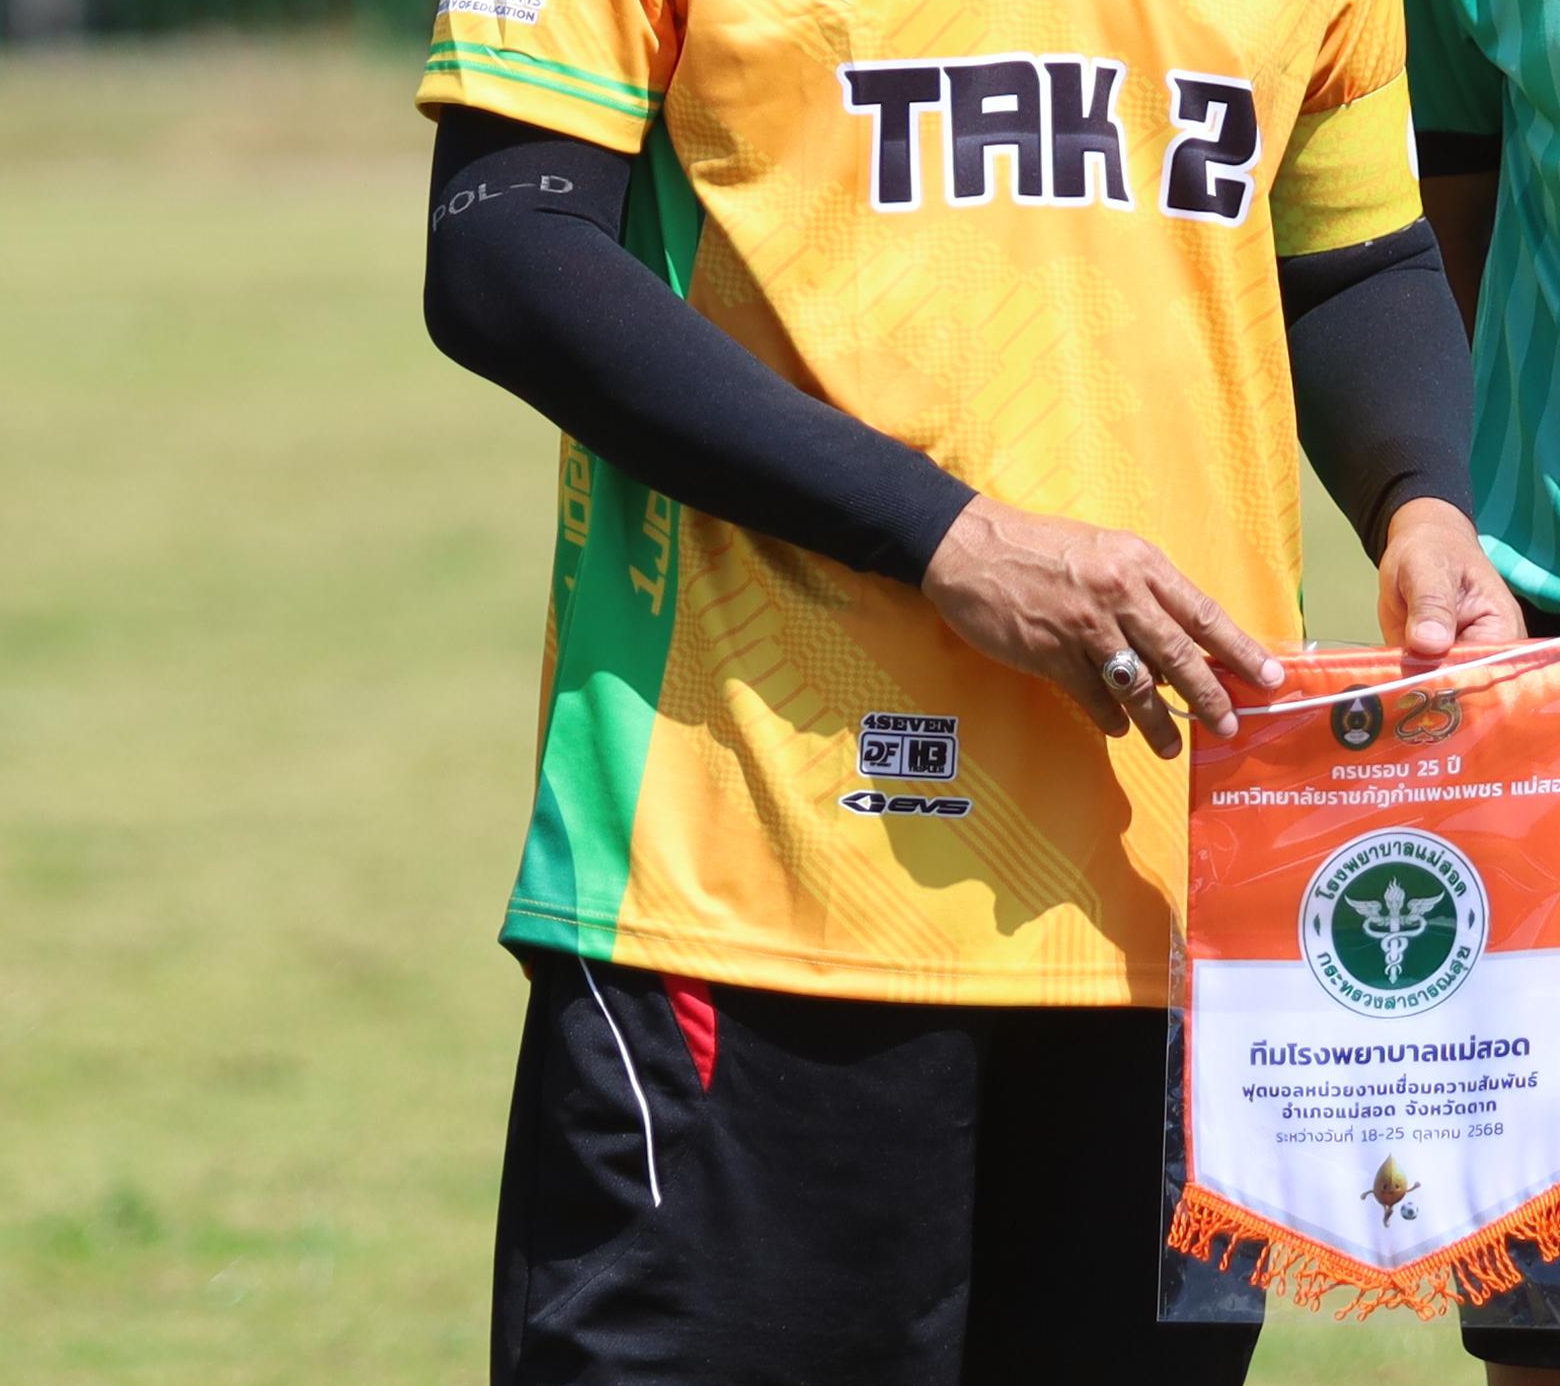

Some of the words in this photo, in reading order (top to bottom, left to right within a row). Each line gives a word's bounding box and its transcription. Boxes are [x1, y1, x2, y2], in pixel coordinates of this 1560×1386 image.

[844, 61, 1130, 203] TAK
[1167, 77, 1258, 219] 2
[863, 714, 957, 734] 4SEVEN
[863, 740, 900, 763] DF
[1331, 762, 1410, 780] ครบรอบ
[1416, 759, 1440, 777] 25
[1446, 755, 1463, 776] ปี
[1211, 781, 1503, 810] มหาวิทยาลัยราชภัฏกำแพงเพชร
[1315, 841, 1468, 900] โรงพยาบาลแม่สอด
[1317, 946, 1472, 1010] กระทรวงสาธารณสุข
[1249, 1035, 1531, 1066] ทีมโรงพยาบาลแม่สอด
[1242, 1072, 1539, 1103] ฟุตบอลหน่วยงานเชื่อมความสัมพันธ์
[1281, 1102, 1396, 1120] อำเภอแม่สอด
[1405, 1099, 1498, 1116] จังหวัดตาก
[1276, 1125, 1354, 1144] ระหว่างวันที่
[1361, 1128, 1405, 1143] 18-25
[1412, 1126, 1461, 1143] ตุลาคม
[1467, 1122, 1505, 1138] 2568
